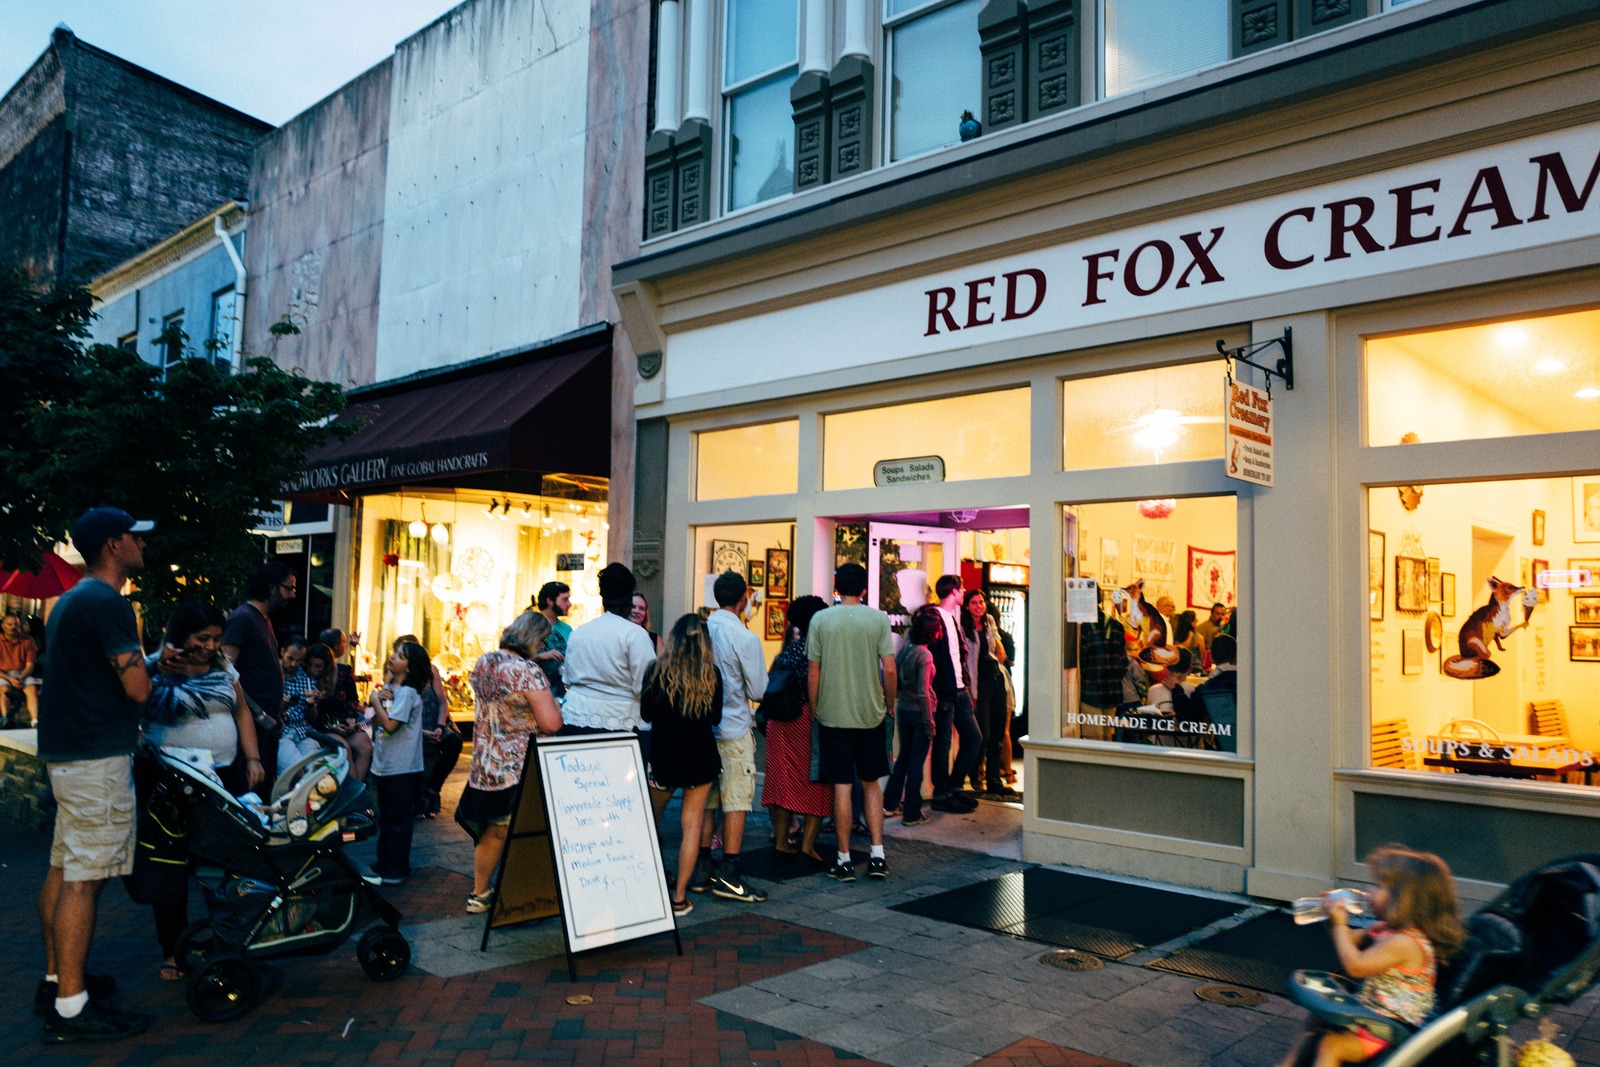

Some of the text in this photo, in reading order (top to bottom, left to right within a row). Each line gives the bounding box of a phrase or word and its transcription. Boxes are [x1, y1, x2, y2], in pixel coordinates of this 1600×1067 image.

[923, 150, 1600, 337] RED FOX CREAM
[1231, 383, 1269, 413] Red Fox
[1229, 401, 1270, 433] Creamery
[279, 451, 489, 493] ANDWORKS GALLERY FINE GLOBAL HANDCRAFTS
[881, 463, 935, 475] Soups Salads
[886, 473, 931, 484] Sandwiches
[1066, 712, 1232, 737] HOMEMADE ICE CREAM
[1401, 736, 1594, 767] SOUPS & SALADS
[574, 774, 610, 792] Special
